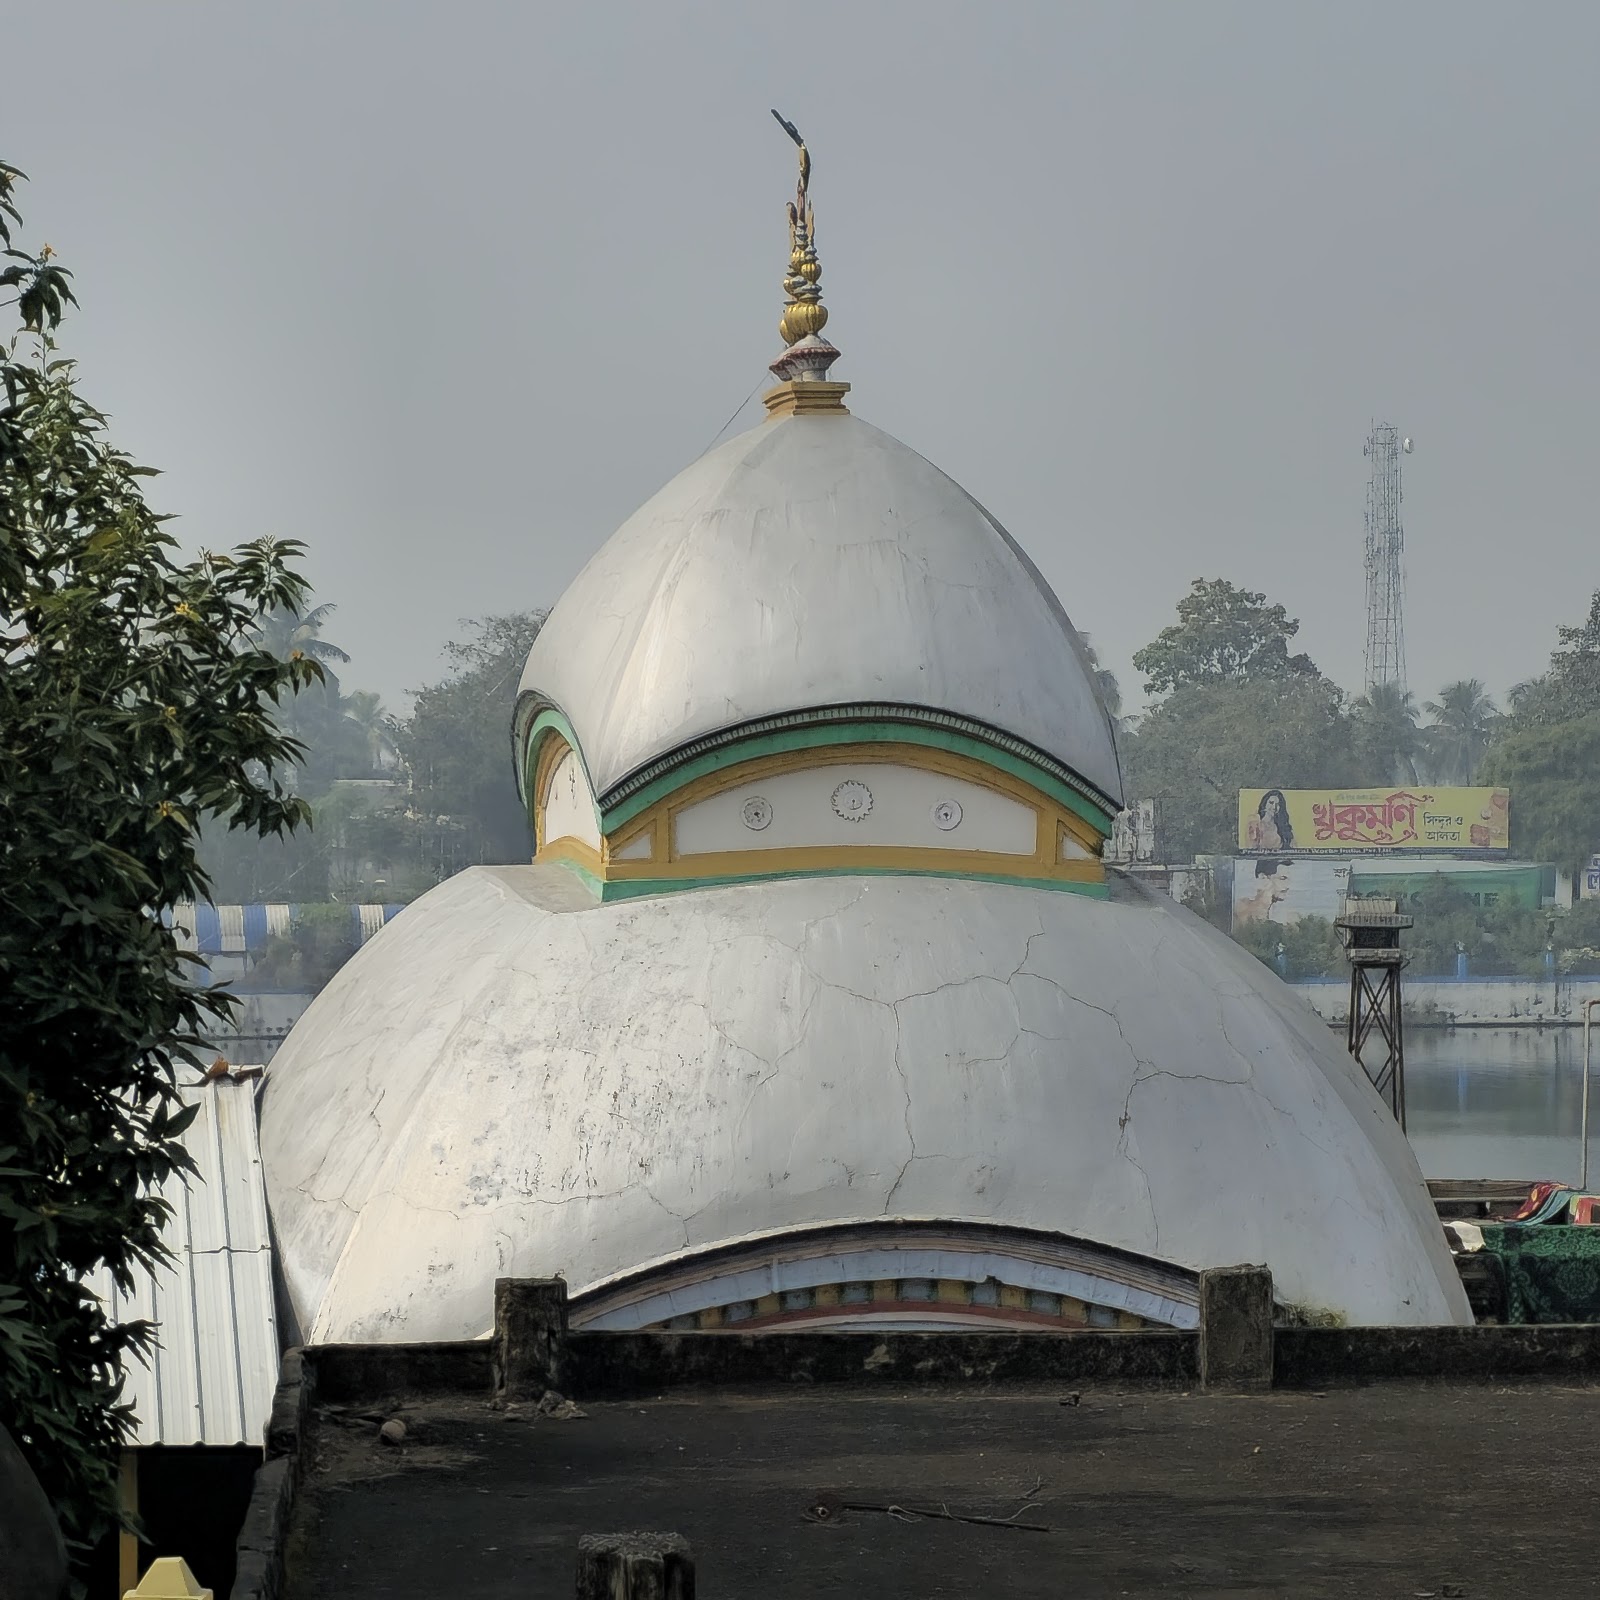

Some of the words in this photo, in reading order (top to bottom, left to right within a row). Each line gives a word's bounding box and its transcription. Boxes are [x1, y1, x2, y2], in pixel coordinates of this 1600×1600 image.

[1312, 791, 1434, 845] খুকুমণি
[1455, 816, 1464, 826] ও
[1425, 831, 1460, 841] আলতা
